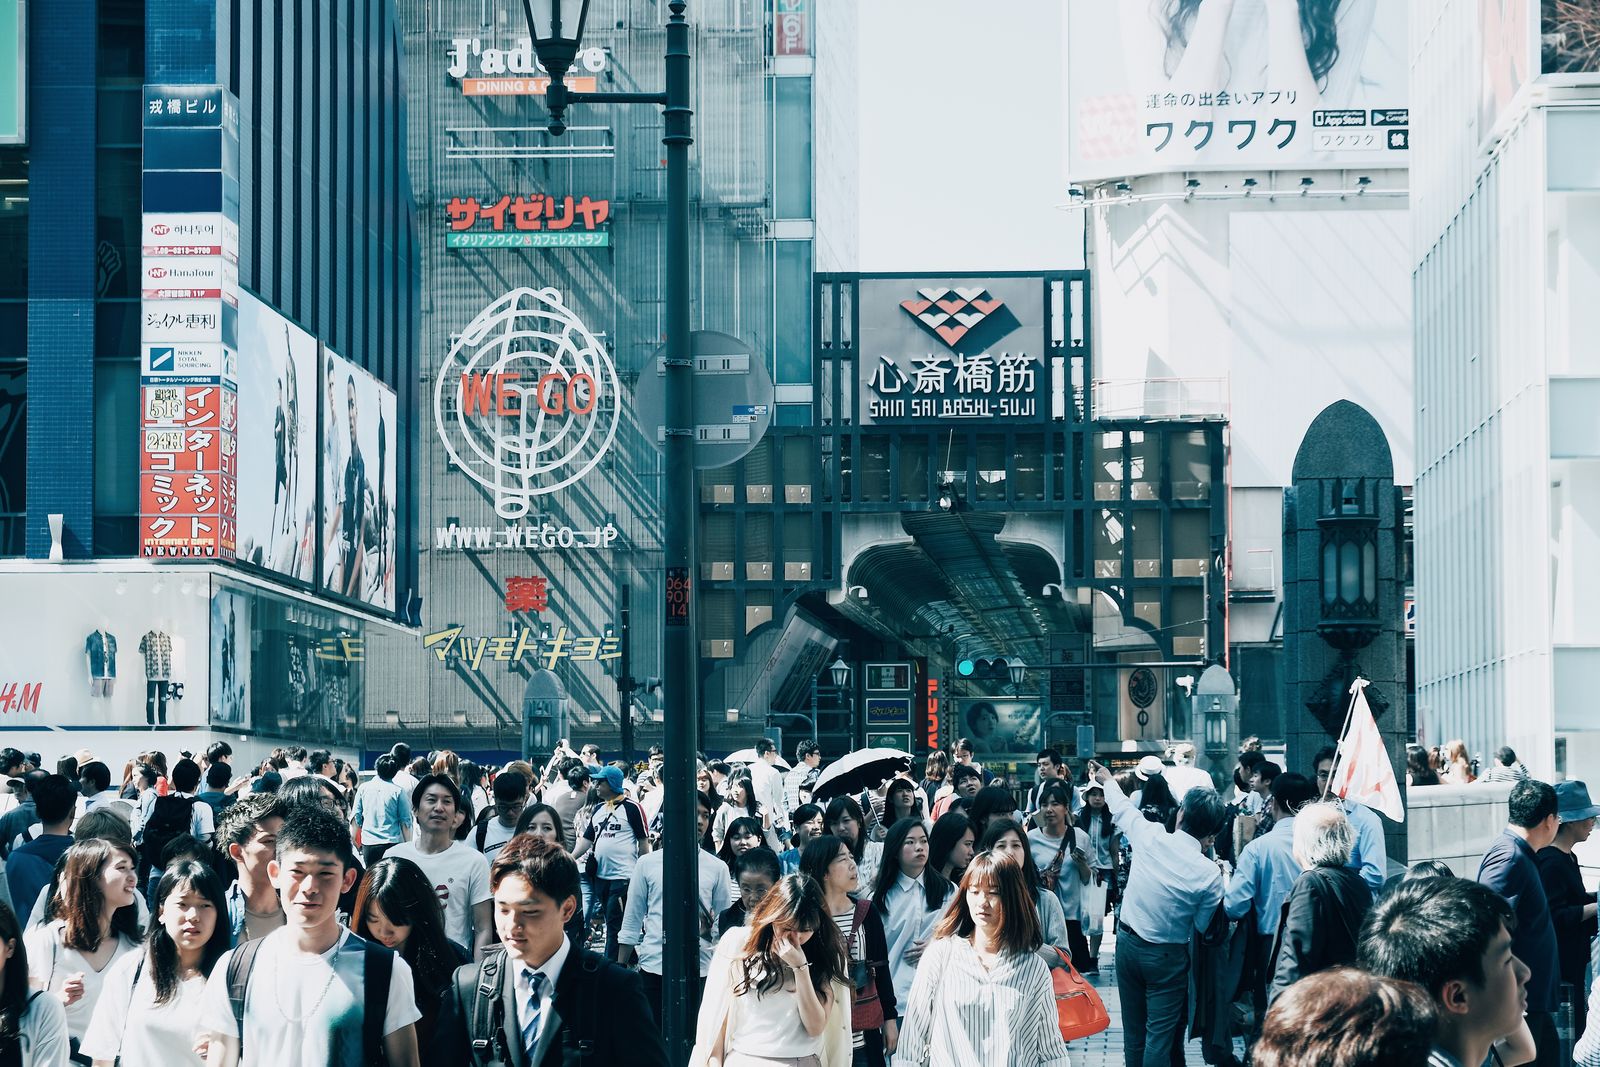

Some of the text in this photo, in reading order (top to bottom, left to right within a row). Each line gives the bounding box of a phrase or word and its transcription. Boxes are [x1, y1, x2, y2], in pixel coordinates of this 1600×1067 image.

[447, 38, 606, 78] J'ade
[476, 80, 525, 93] DINING
[527, 80, 538, 92] &
[149, 98, 217, 115] 戎橋ビル
[1146, 118, 1297, 153] ワクワク
[1320, 134, 1374, 146] ワクワク
[446, 192, 610, 231] サイゼリヤ
[867, 352, 1037, 394] 心斎橋筋
[150, 399, 182, 418] 5F
[869, 398, 905, 417] SHIN
[911, 398, 936, 416] SAI
[147, 432, 183, 450] 24H
[184, 387, 216, 539] インターネット
[149, 453, 179, 539] コミック
[435, 525, 618, 549] WWW.WEGO.JP
[505, 575, 547, 613] 薬
[423, 625, 624, 671] マツモトキヨシ
[0, 682, 43, 714] H&M
[609, 823, 622, 831] 28
